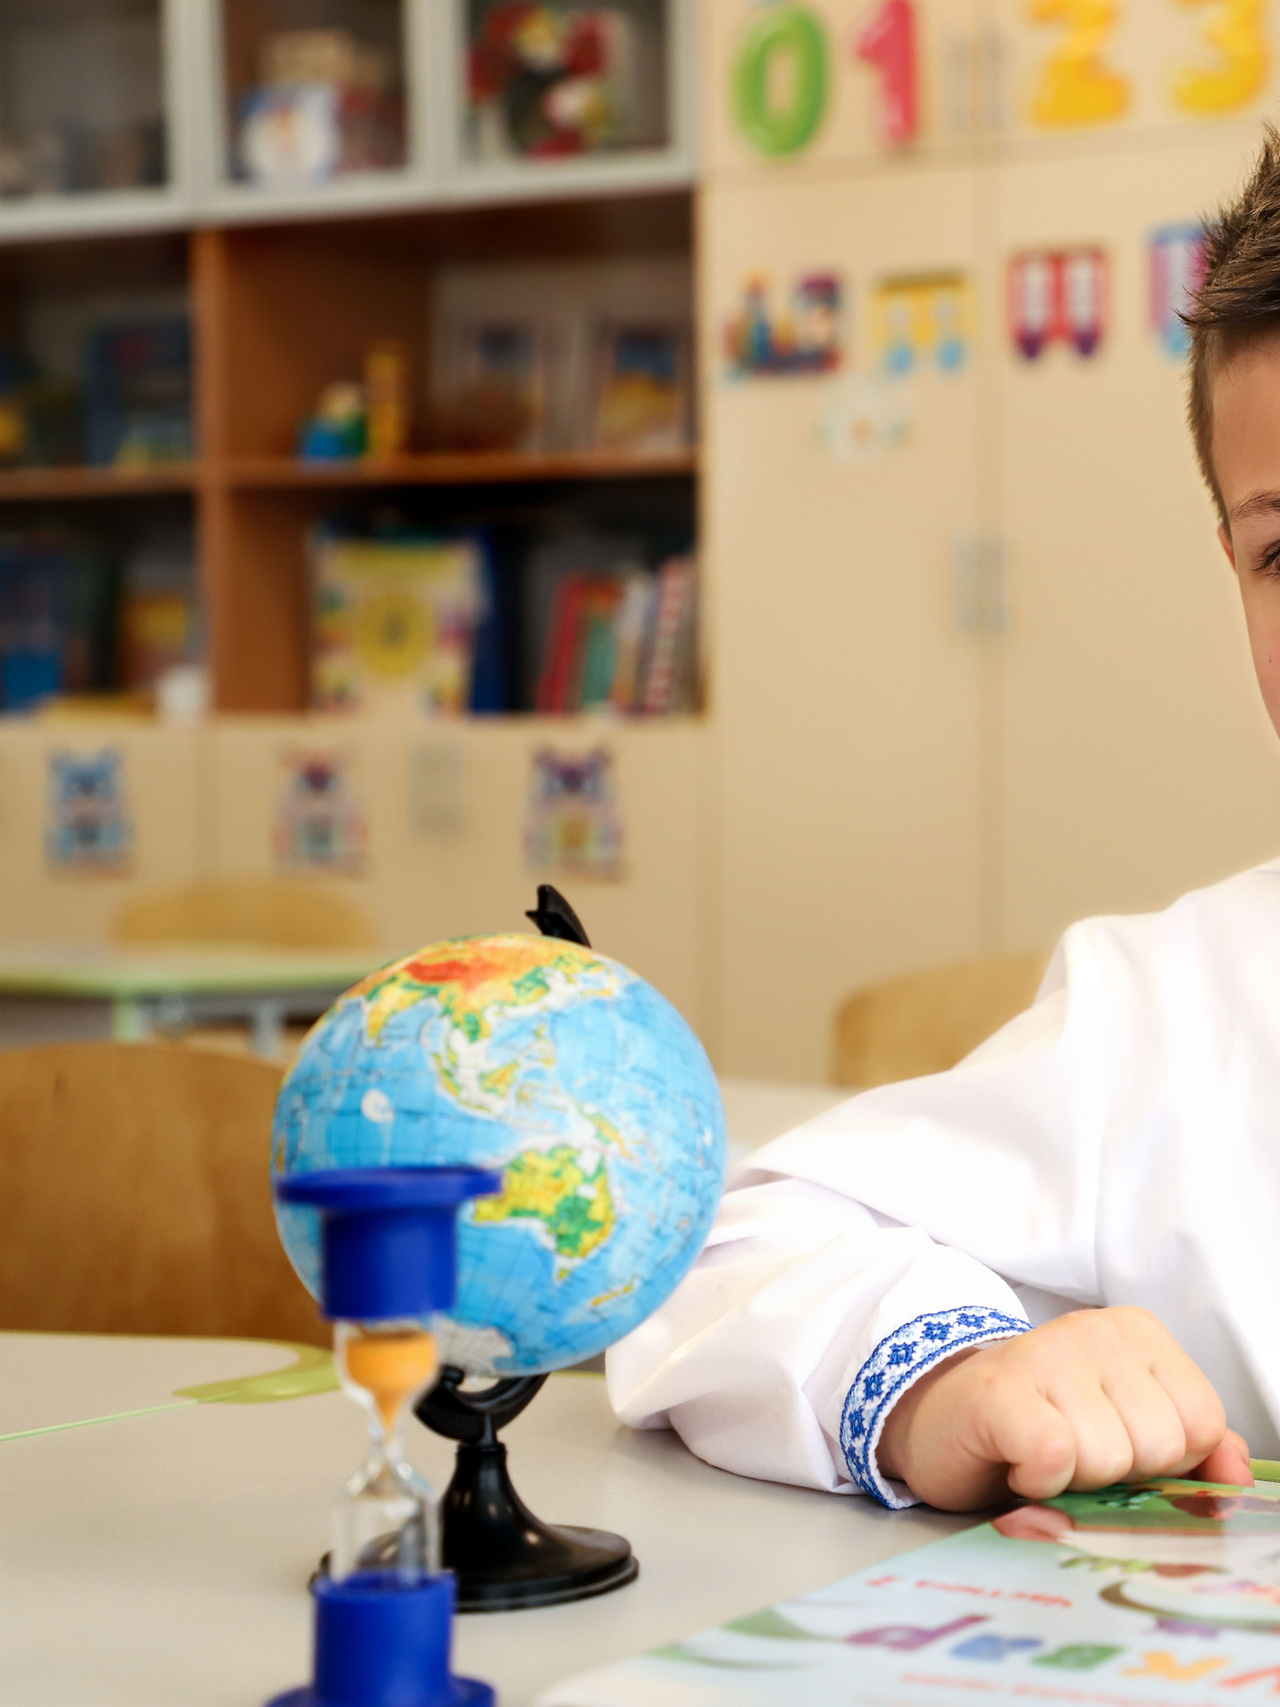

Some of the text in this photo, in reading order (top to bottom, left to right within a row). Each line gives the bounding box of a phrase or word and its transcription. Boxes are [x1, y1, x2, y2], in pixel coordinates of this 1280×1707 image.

[731, 4, 830, 157] 0
[853, 0, 922, 146] 1
[1028, 0, 1130, 130] 2
[1172, 0, 1270, 114] 3
